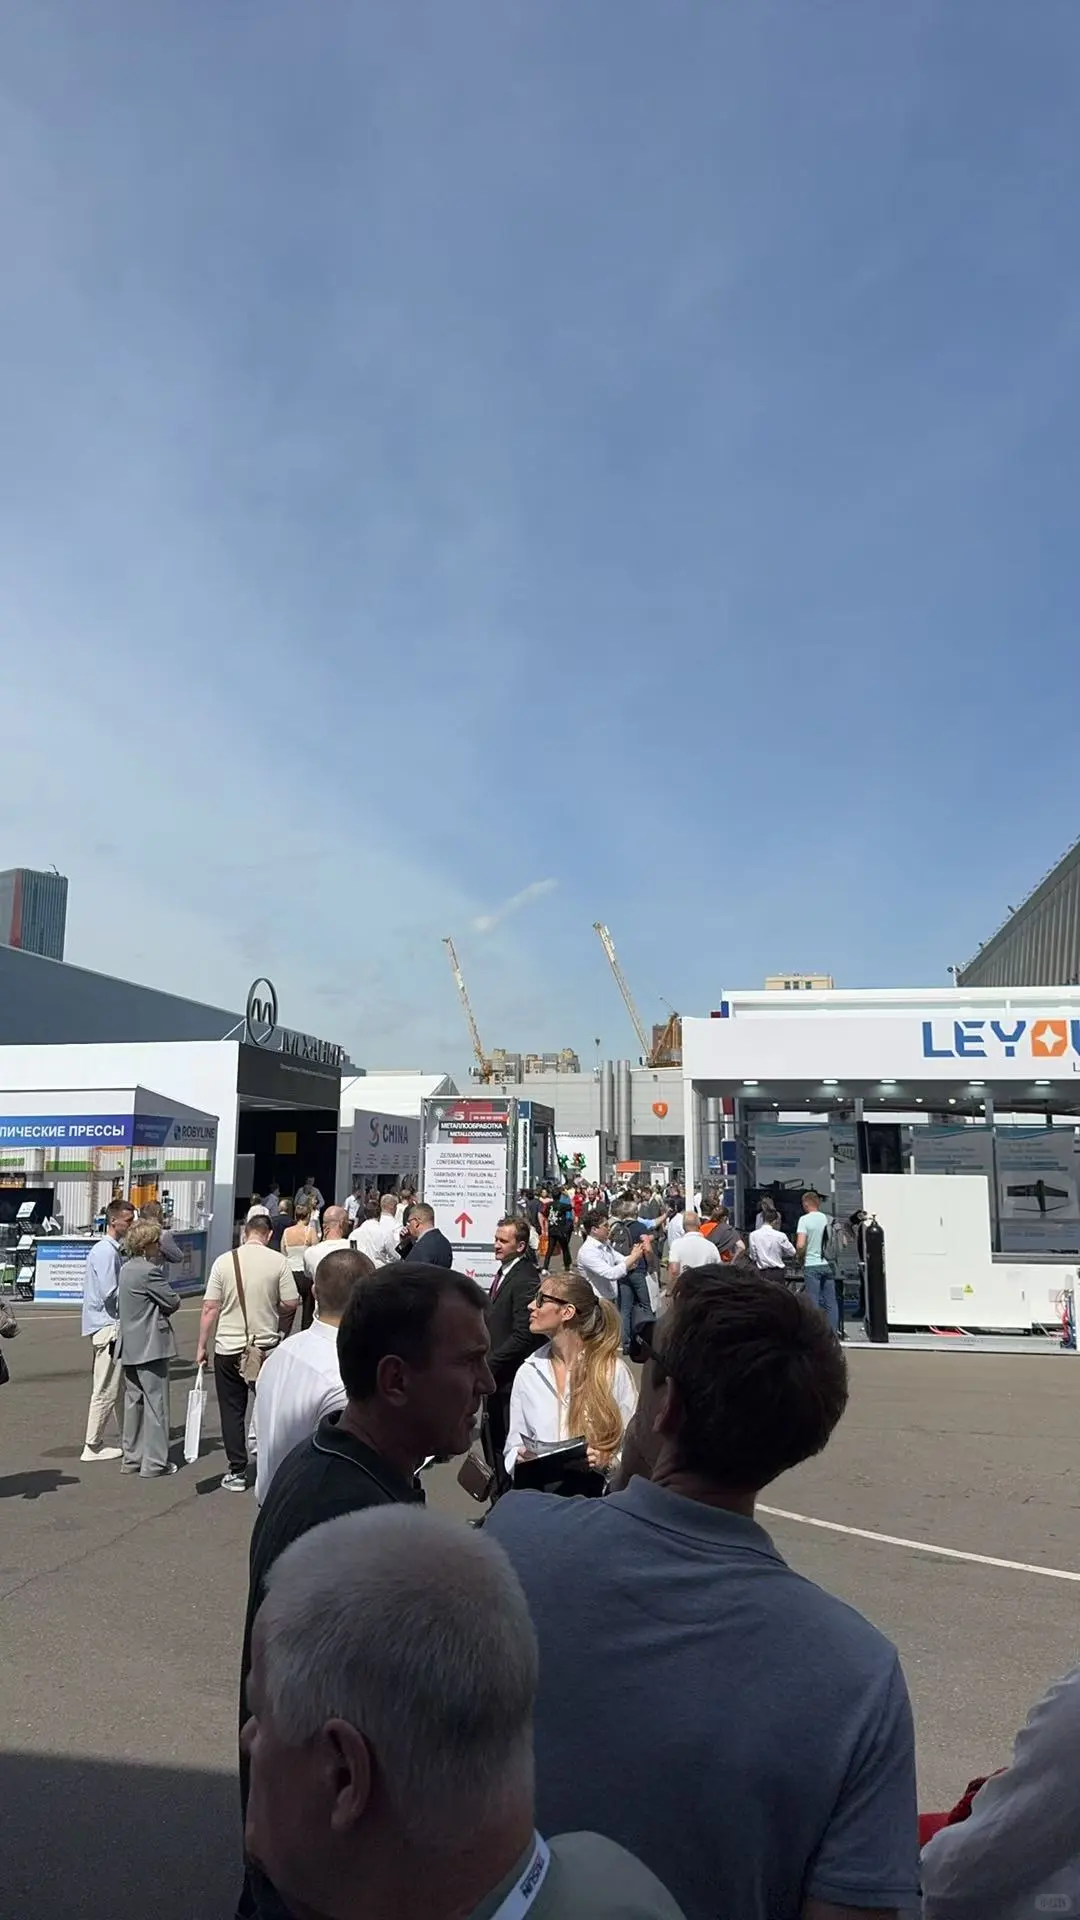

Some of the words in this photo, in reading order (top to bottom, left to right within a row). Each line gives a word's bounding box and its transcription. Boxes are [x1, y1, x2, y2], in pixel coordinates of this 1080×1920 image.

[922, 1020, 1080, 1057] LEYO
[69, 1125, 124, 1137] ПРЕССЫ
[383, 1125, 408, 1144] CHINA
